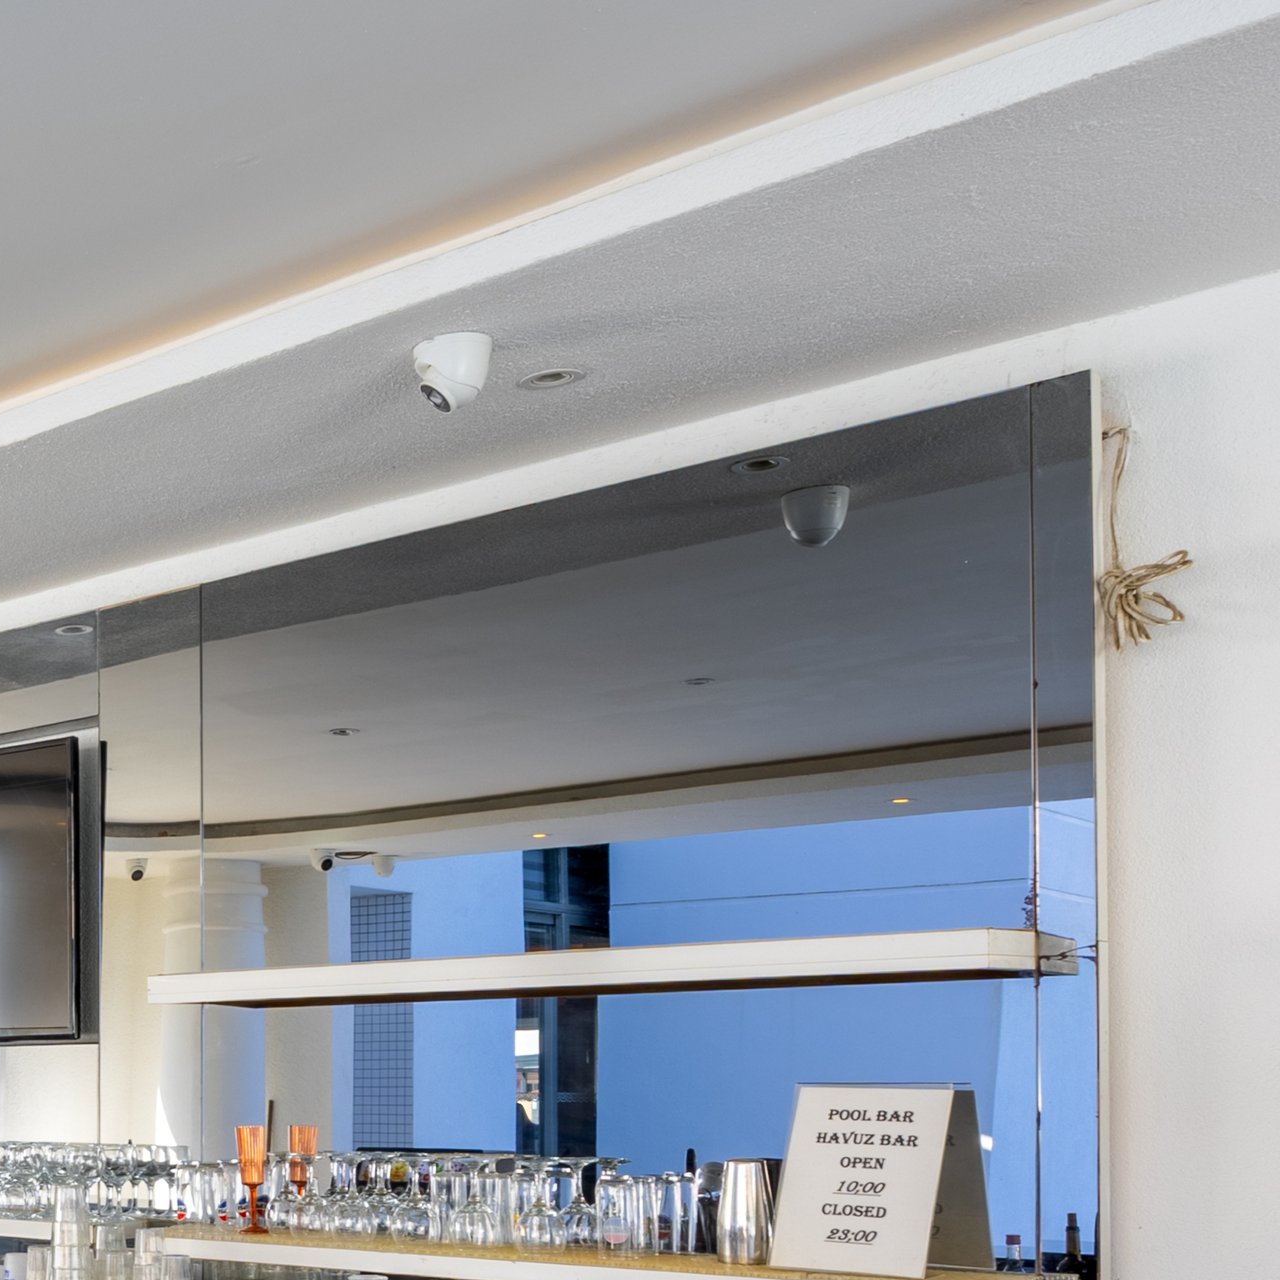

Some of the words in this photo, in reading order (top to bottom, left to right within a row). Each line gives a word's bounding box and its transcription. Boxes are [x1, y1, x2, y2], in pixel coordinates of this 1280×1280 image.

[828, 1109, 871, 1121] POOL
[876, 1110, 915, 1123] BAR
[816, 1131, 875, 1146] HAVUZ
[880, 1134, 919, 1148] BAR
[840, 1156, 886, 1170] OPEN
[822, 1203, 887, 1219] CLOSED
